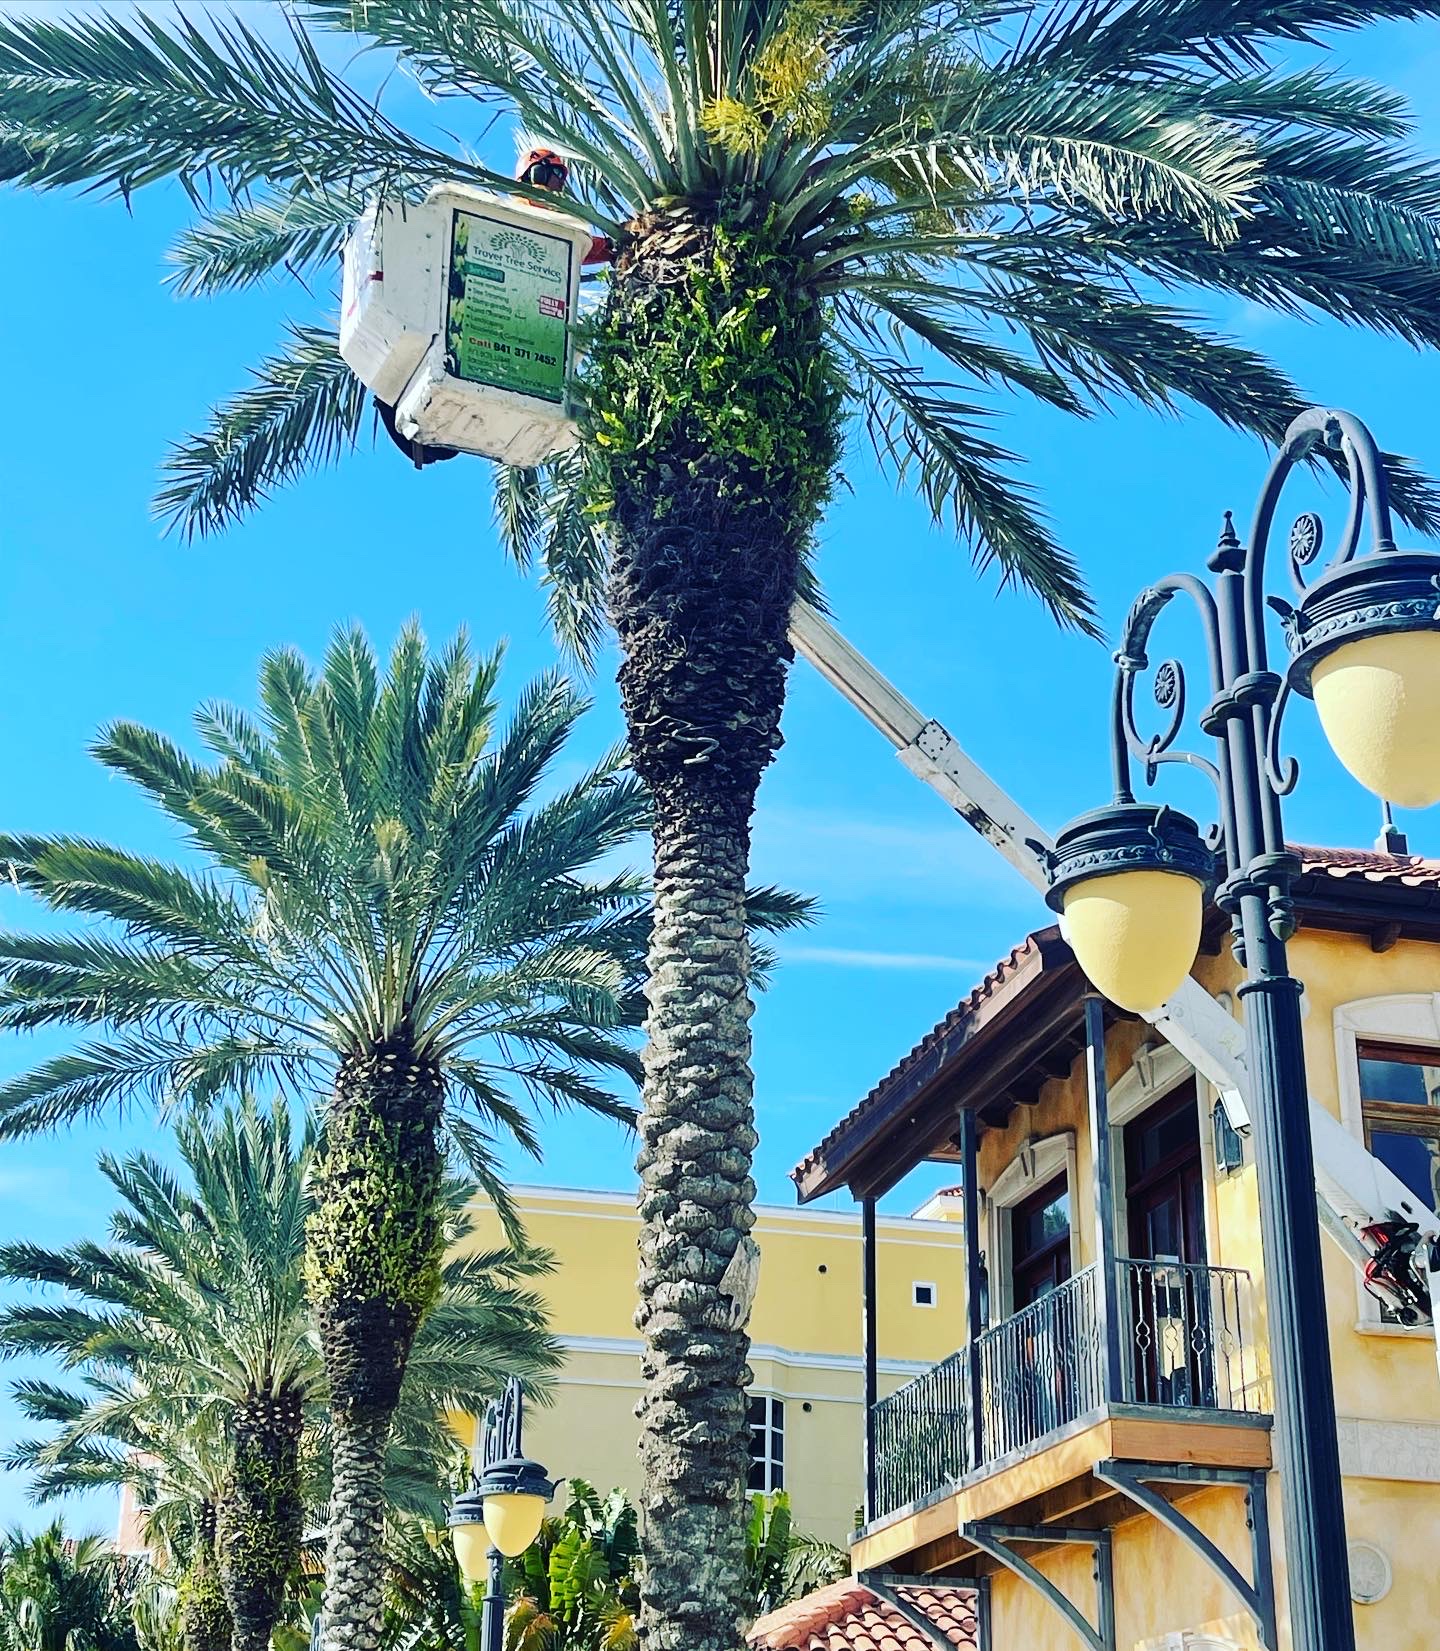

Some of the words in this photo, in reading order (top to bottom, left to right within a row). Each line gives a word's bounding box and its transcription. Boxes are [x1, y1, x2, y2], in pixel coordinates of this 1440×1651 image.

[473, 245, 503, 260] Troyer
[505, 254, 526, 268] Tree
[527, 261, 561, 278] Service
[540, 297, 559, 308] FULLY
[469, 337, 491, 349] Call
[514, 347, 531, 360] 371
[534, 352, 557, 367] 7452
